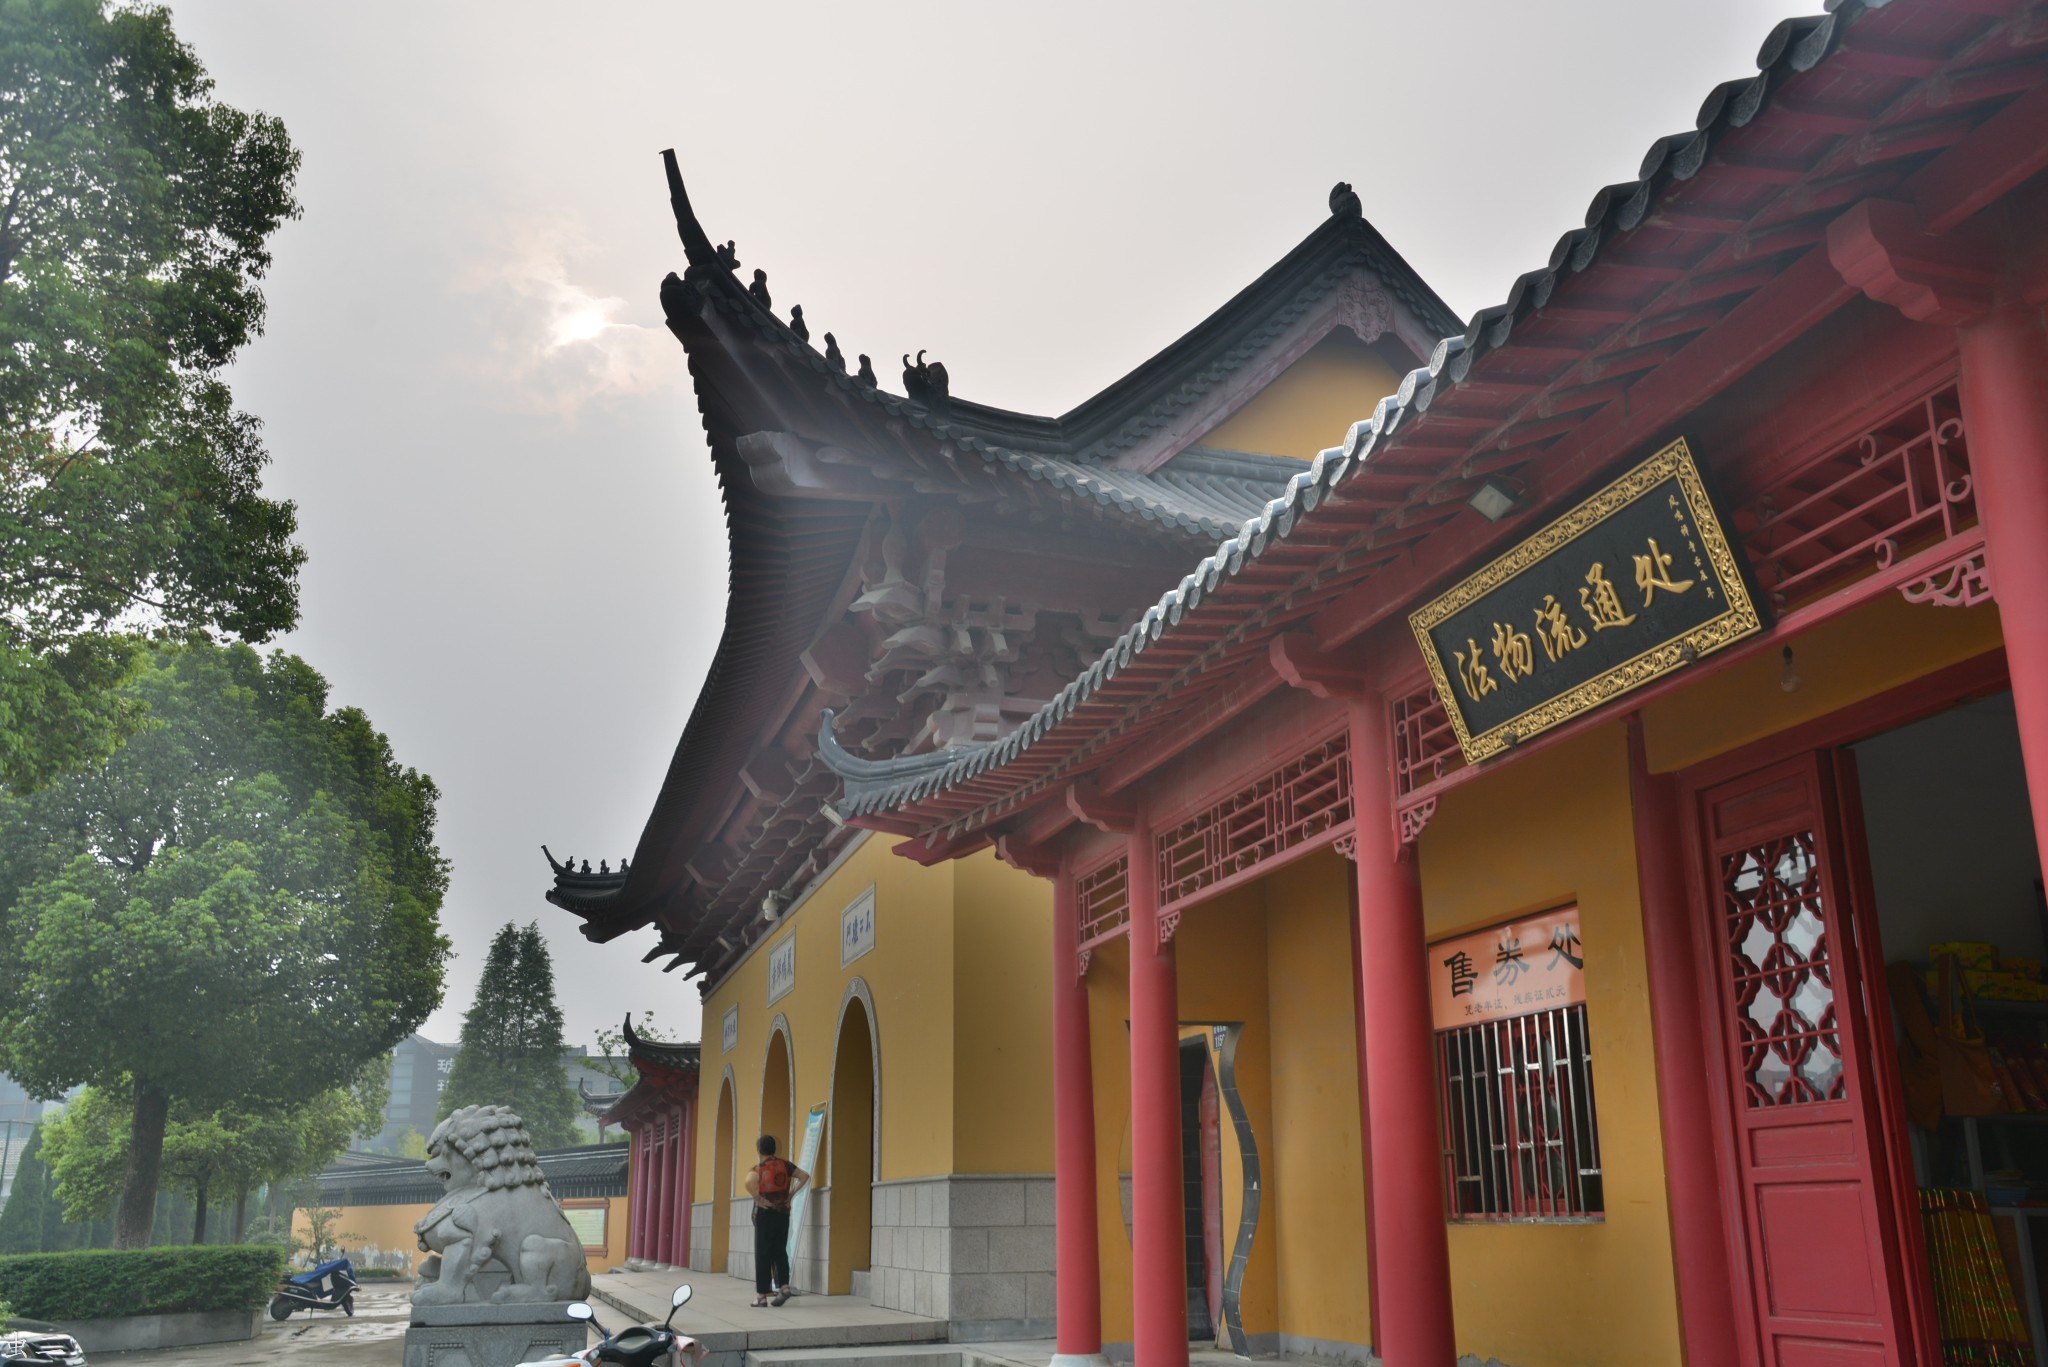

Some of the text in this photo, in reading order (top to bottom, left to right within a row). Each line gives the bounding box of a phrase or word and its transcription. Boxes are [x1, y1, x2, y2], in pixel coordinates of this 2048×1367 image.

[1454, 538, 1694, 701] 法物流通处
[1443, 923, 1584, 998] 售券处
